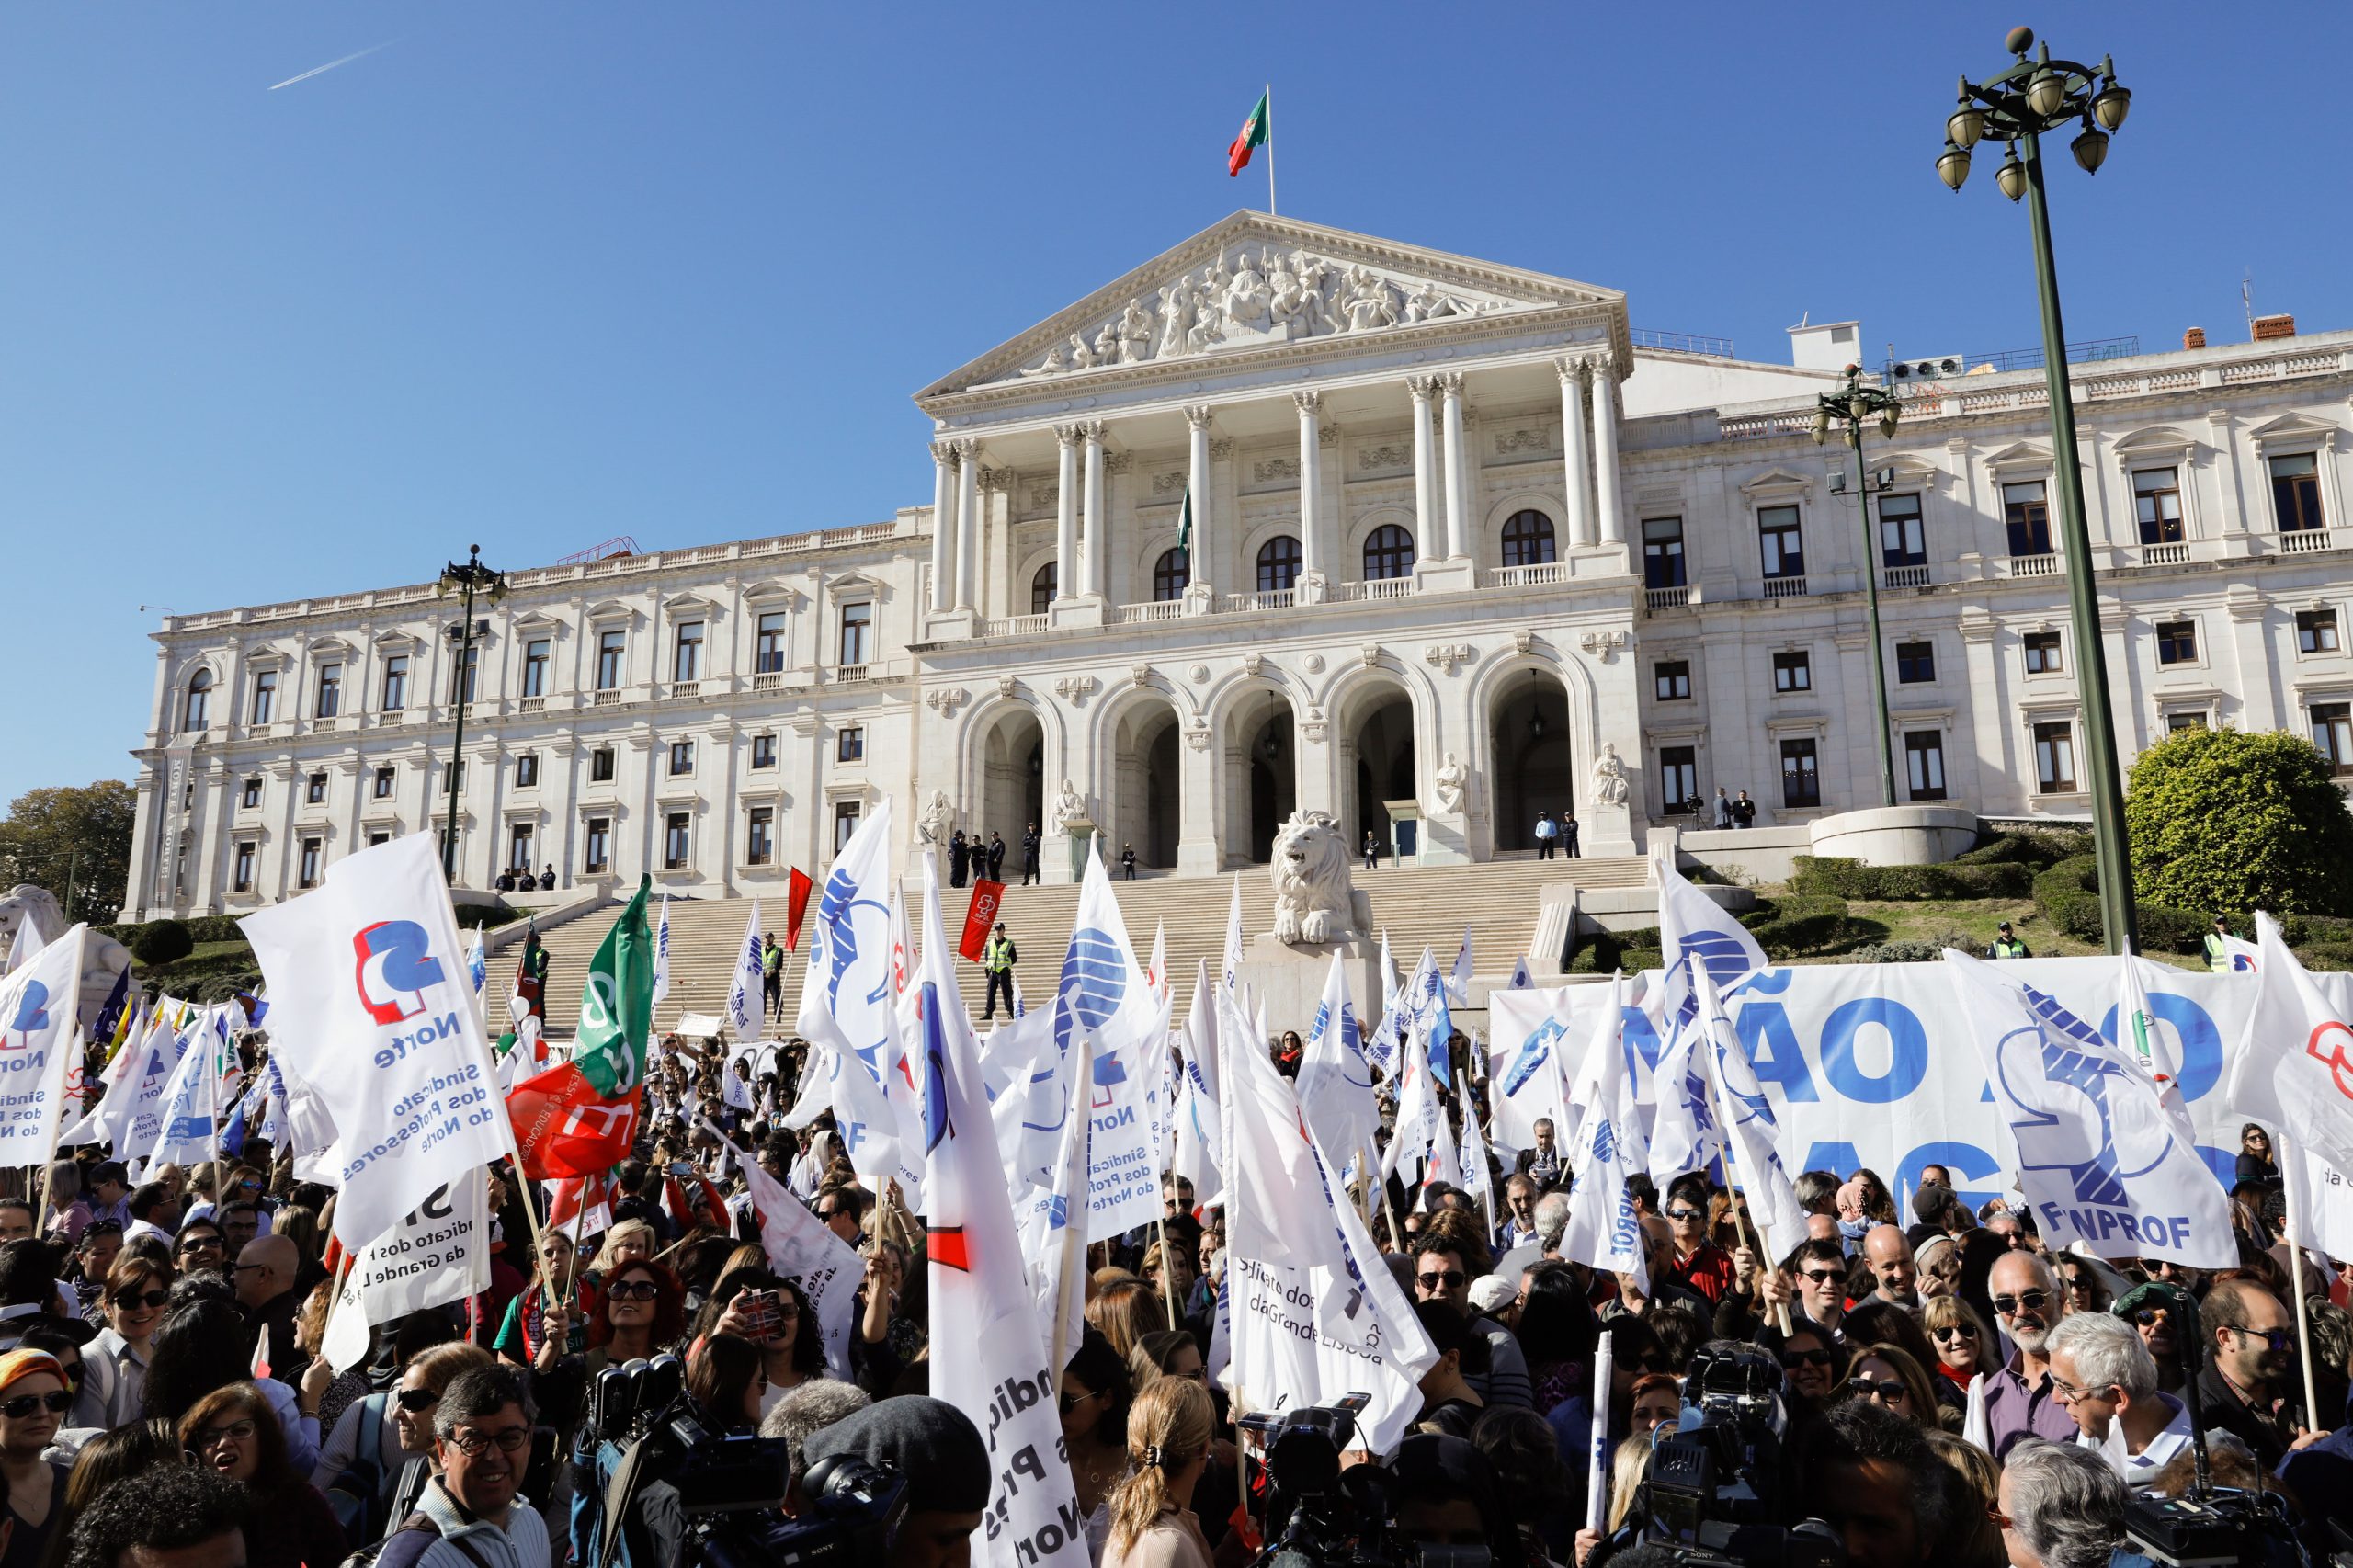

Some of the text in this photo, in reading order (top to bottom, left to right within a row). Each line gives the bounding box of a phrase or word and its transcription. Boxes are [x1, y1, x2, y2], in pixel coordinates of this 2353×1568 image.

[2039, 1201, 2190, 1249] FNPROF
[1286, 1285, 1315, 1310] dos
[1249, 1293, 1269, 1313] da
[1268, 1303, 1318, 1344] Grande
[811, 1543, 834, 1557] SONY
